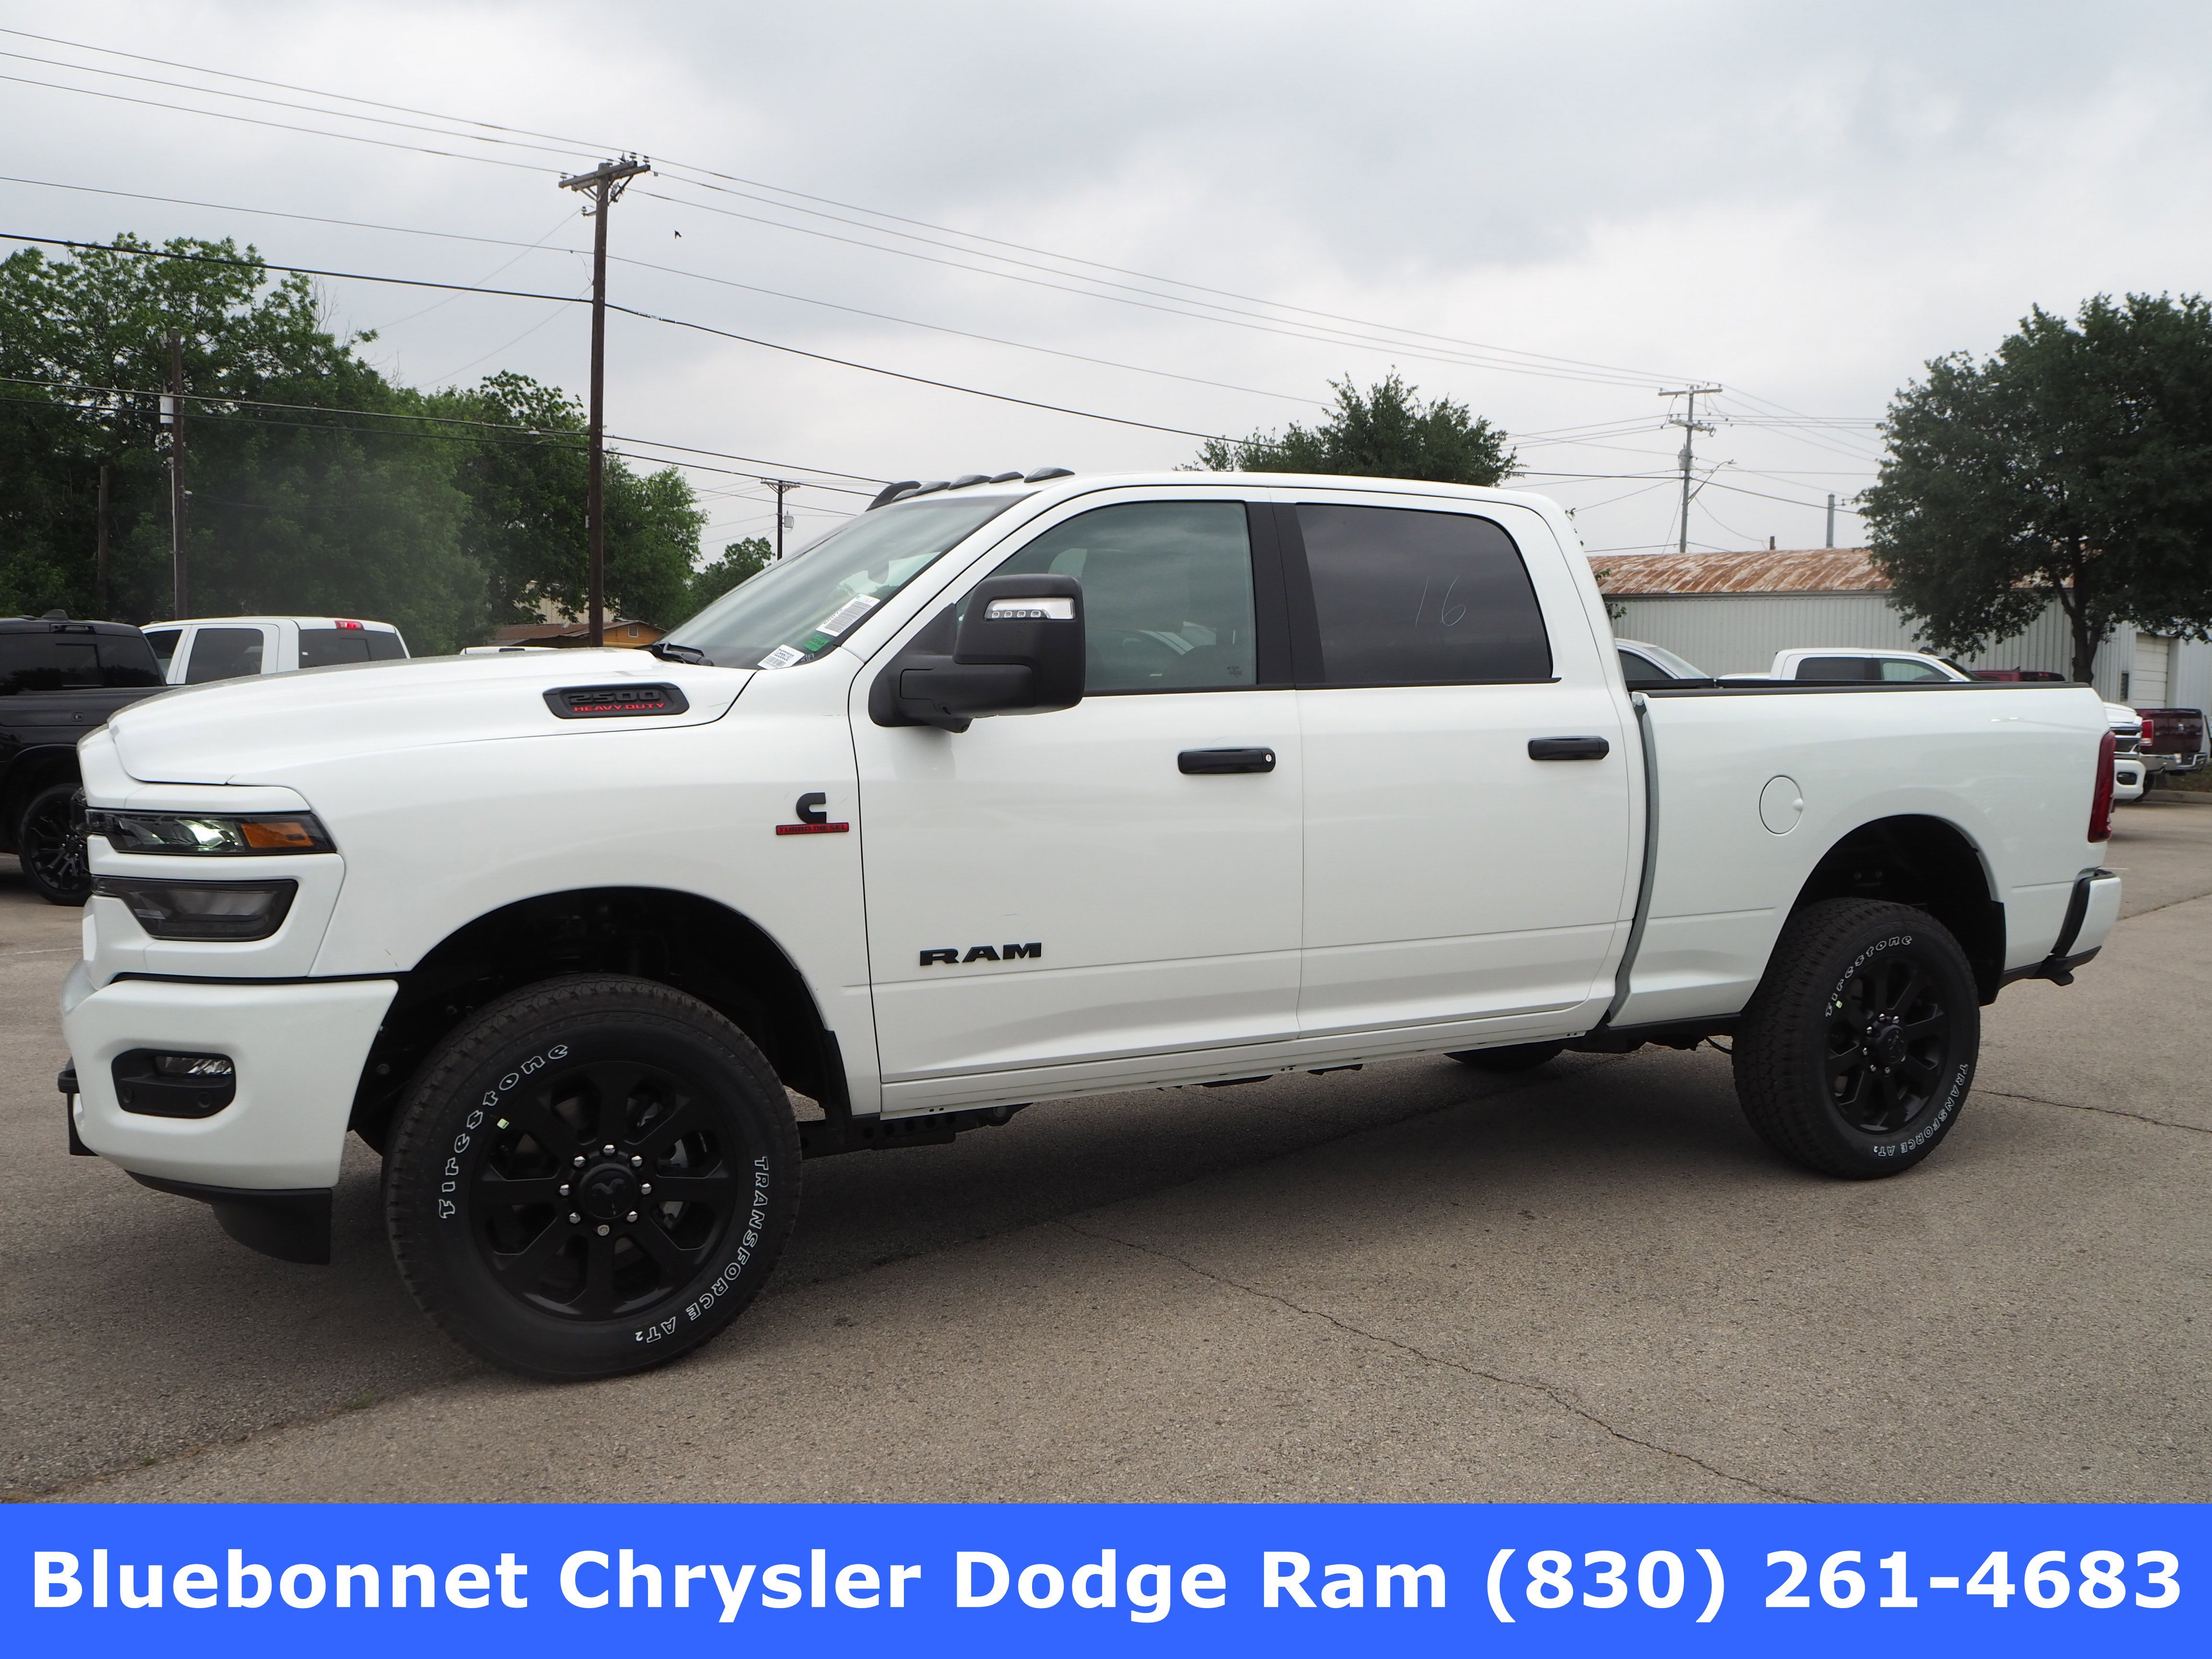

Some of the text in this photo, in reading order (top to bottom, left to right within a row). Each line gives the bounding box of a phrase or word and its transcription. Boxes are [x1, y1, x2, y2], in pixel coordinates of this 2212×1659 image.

[1415, 576, 1466, 628] 16
[568, 691, 660, 705] 2500
[920, 942, 1042, 966] RAM
[1900, 1064, 1968, 1154] TRANSFORCE
[685, 1157, 769, 1321] TRANSFORCE
